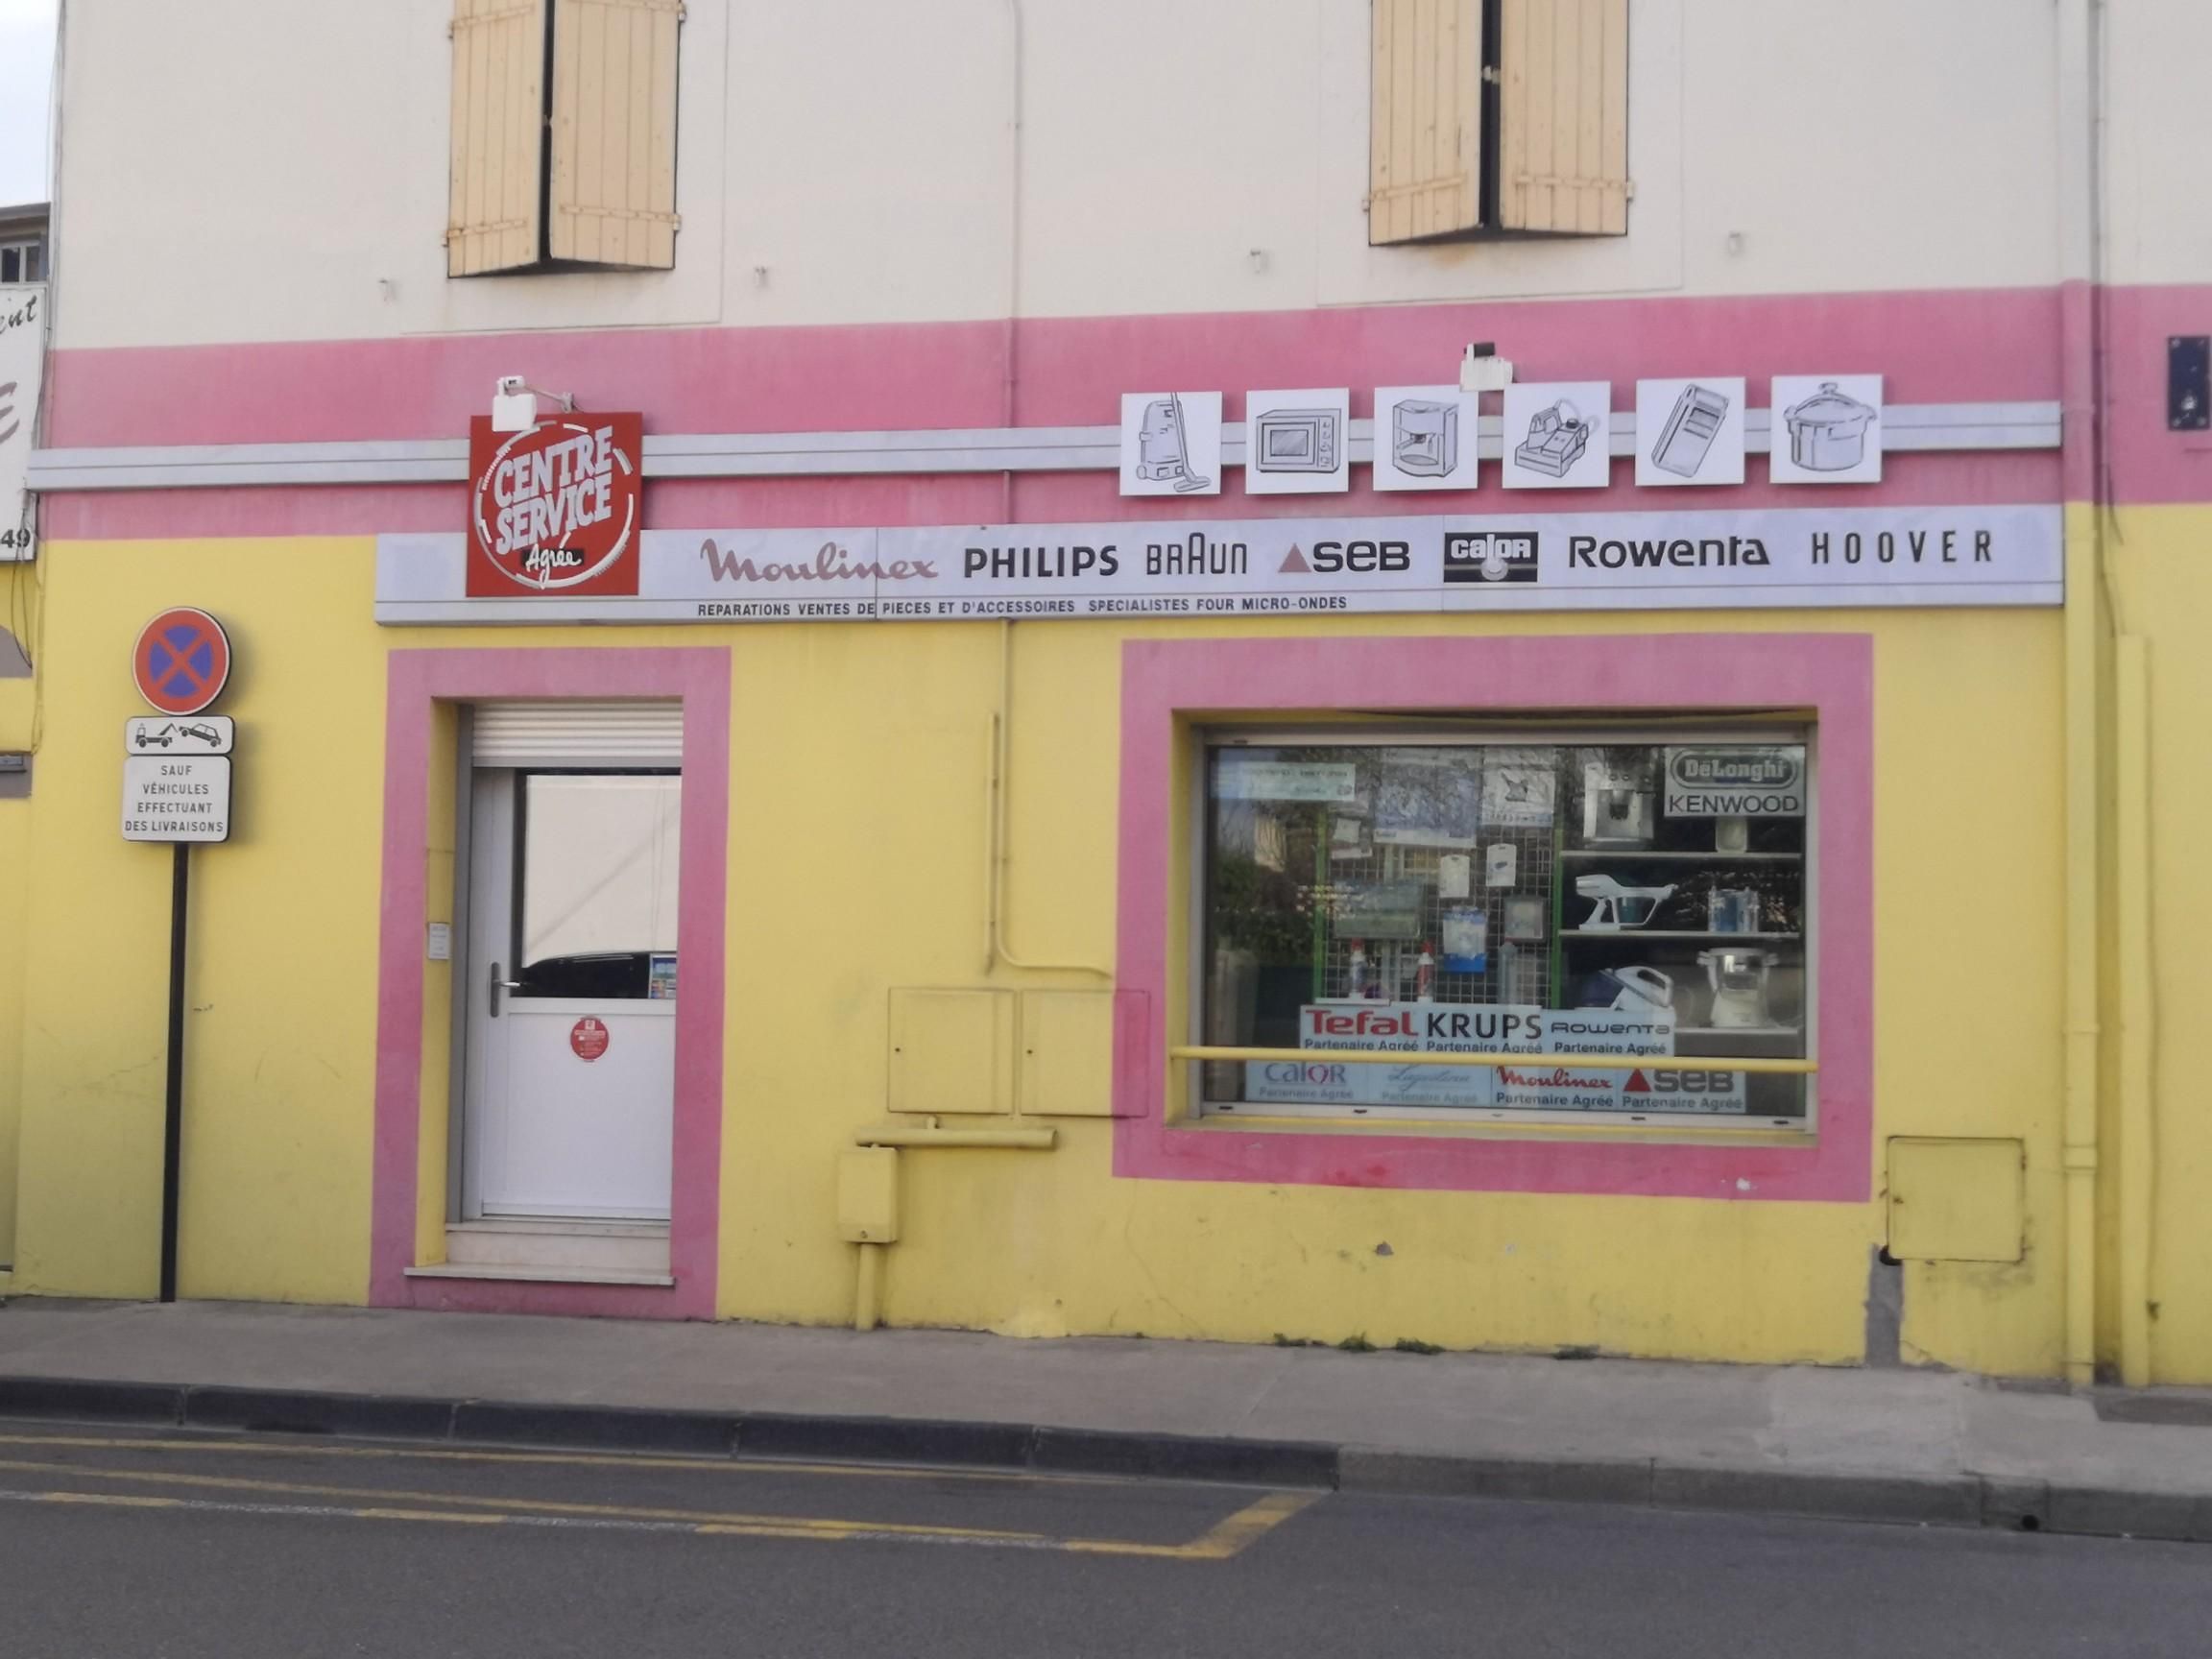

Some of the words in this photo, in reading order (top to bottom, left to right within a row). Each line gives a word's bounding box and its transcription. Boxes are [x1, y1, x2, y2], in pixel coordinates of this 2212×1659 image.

[494, 426, 613, 508] CENTRE
[495, 472, 613, 555] SERVICE
[526, 532, 582, 589] Agrée
[700, 539, 938, 582] Moulinex
[964, 544, 1118, 578] PHILIPS
[1569, 534, 1770, 568] Rowenta
[1812, 530, 1993, 565] HOOVER
[698, 603, 791, 616] REPARATIONS
[799, 603, 850, 615] VENTES
[857, 602, 876, 614] DE
[883, 602, 931, 614] PIECES
[939, 602, 954, 614] ET
[962, 600, 1075, 613] D'ACCESSOIRES
[1089, 599, 1190, 613] SPECIALISTES
[1197, 598, 1235, 611] FOUR
[1242, 596, 1347, 611] MICRO-ONDES
[161, 765, 192, 776] SAUF
[143, 781, 209, 795] VÉHICULES
[137, 802, 212, 813] EFFECTUANT
[1670, 795, 1798, 813] KENWOOD
[125, 820, 148, 831] DES
[152, 821, 224, 832] LIVRAISONS
[1306, 1010, 1419, 1036] Tefal
[1428, 1013, 1542, 1040] KRUPS
[1305, 1039, 1375, 1050] Partenaire
[1427, 1040, 1497, 1052] Partenaire
[1554, 1042, 1623, 1053] Partenaire
[1497, 1066, 1613, 1089] Moulinex
[1496, 1093, 1568, 1105] Partenaire
[1623, 1095, 1695, 1108] Partenaire
